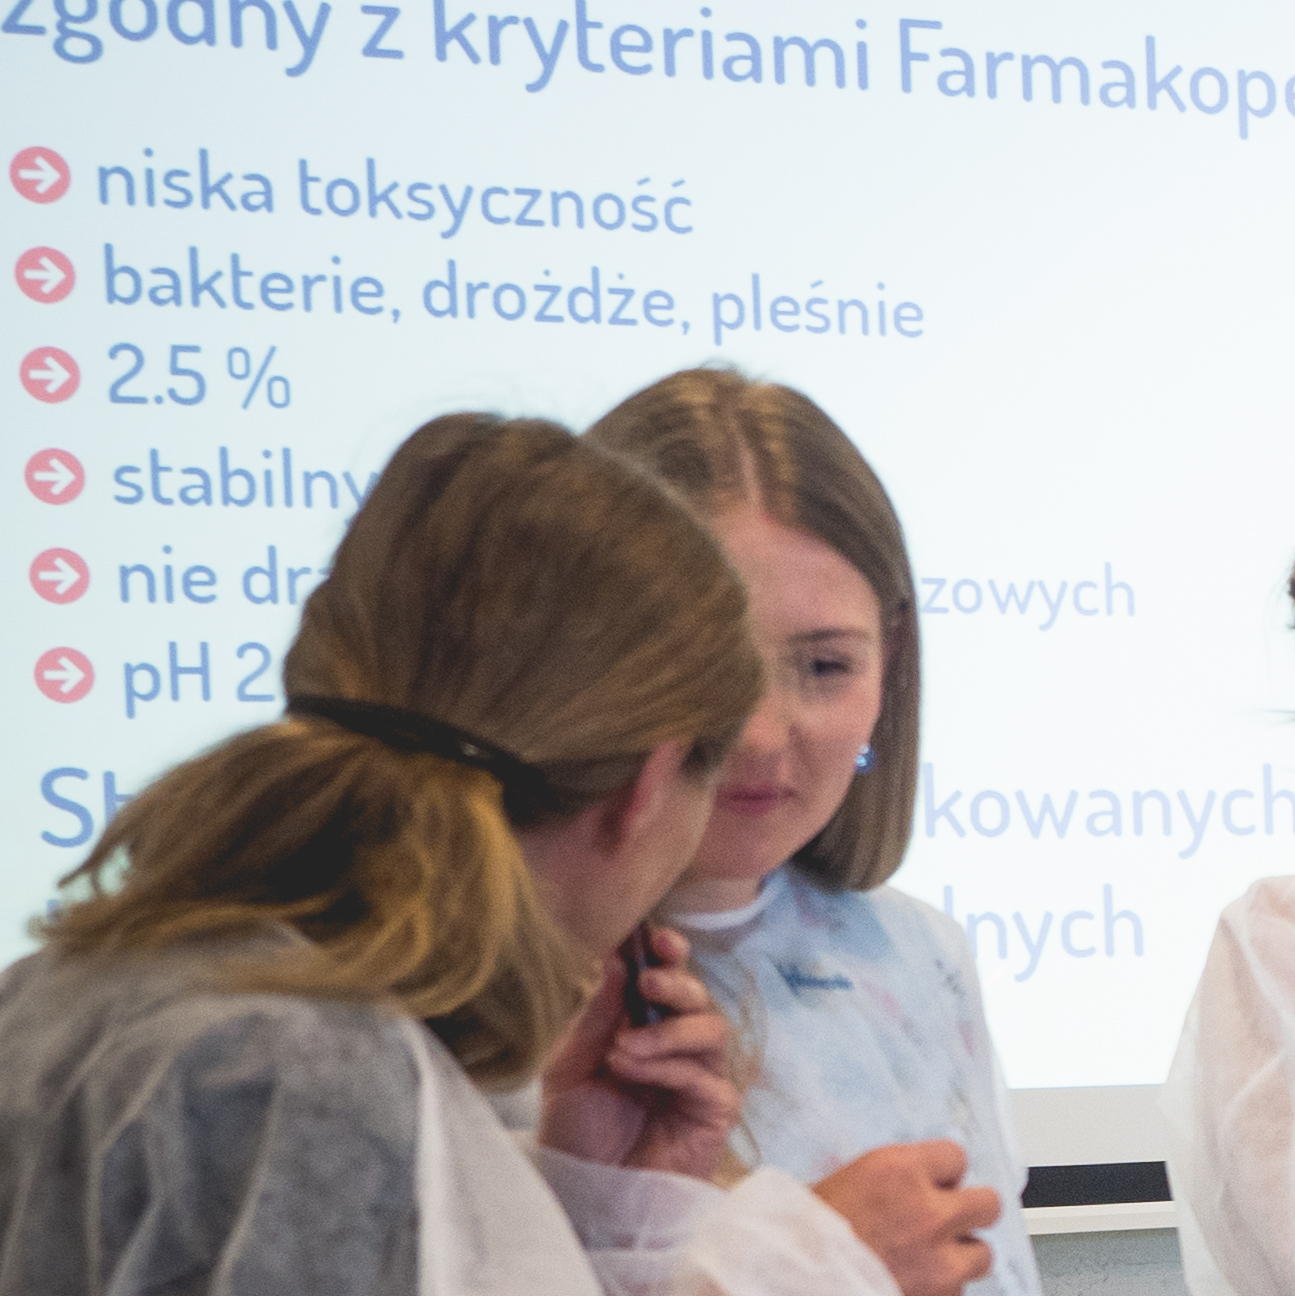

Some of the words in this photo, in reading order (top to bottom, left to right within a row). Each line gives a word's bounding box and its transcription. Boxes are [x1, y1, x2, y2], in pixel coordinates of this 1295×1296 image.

[0, 0, 331, 77] zgodny
[361, 5, 404, 59] z
[433, 0, 870, 92] kryteriami
[96, 148, 274, 213] niska
[299, 157, 694, 239] toksyczność
[103, 243, 402, 324] bakterie,
[423, 259, 691, 335] drożdże,
[712, 274, 925, 346] pleśnie
[107, 343, 205, 407] 2.5
[226, 344, 291, 409] %
[118, 545, 218, 604] nie
[124, 641, 211, 719] pH
[236, 641, 276, 702] 2
